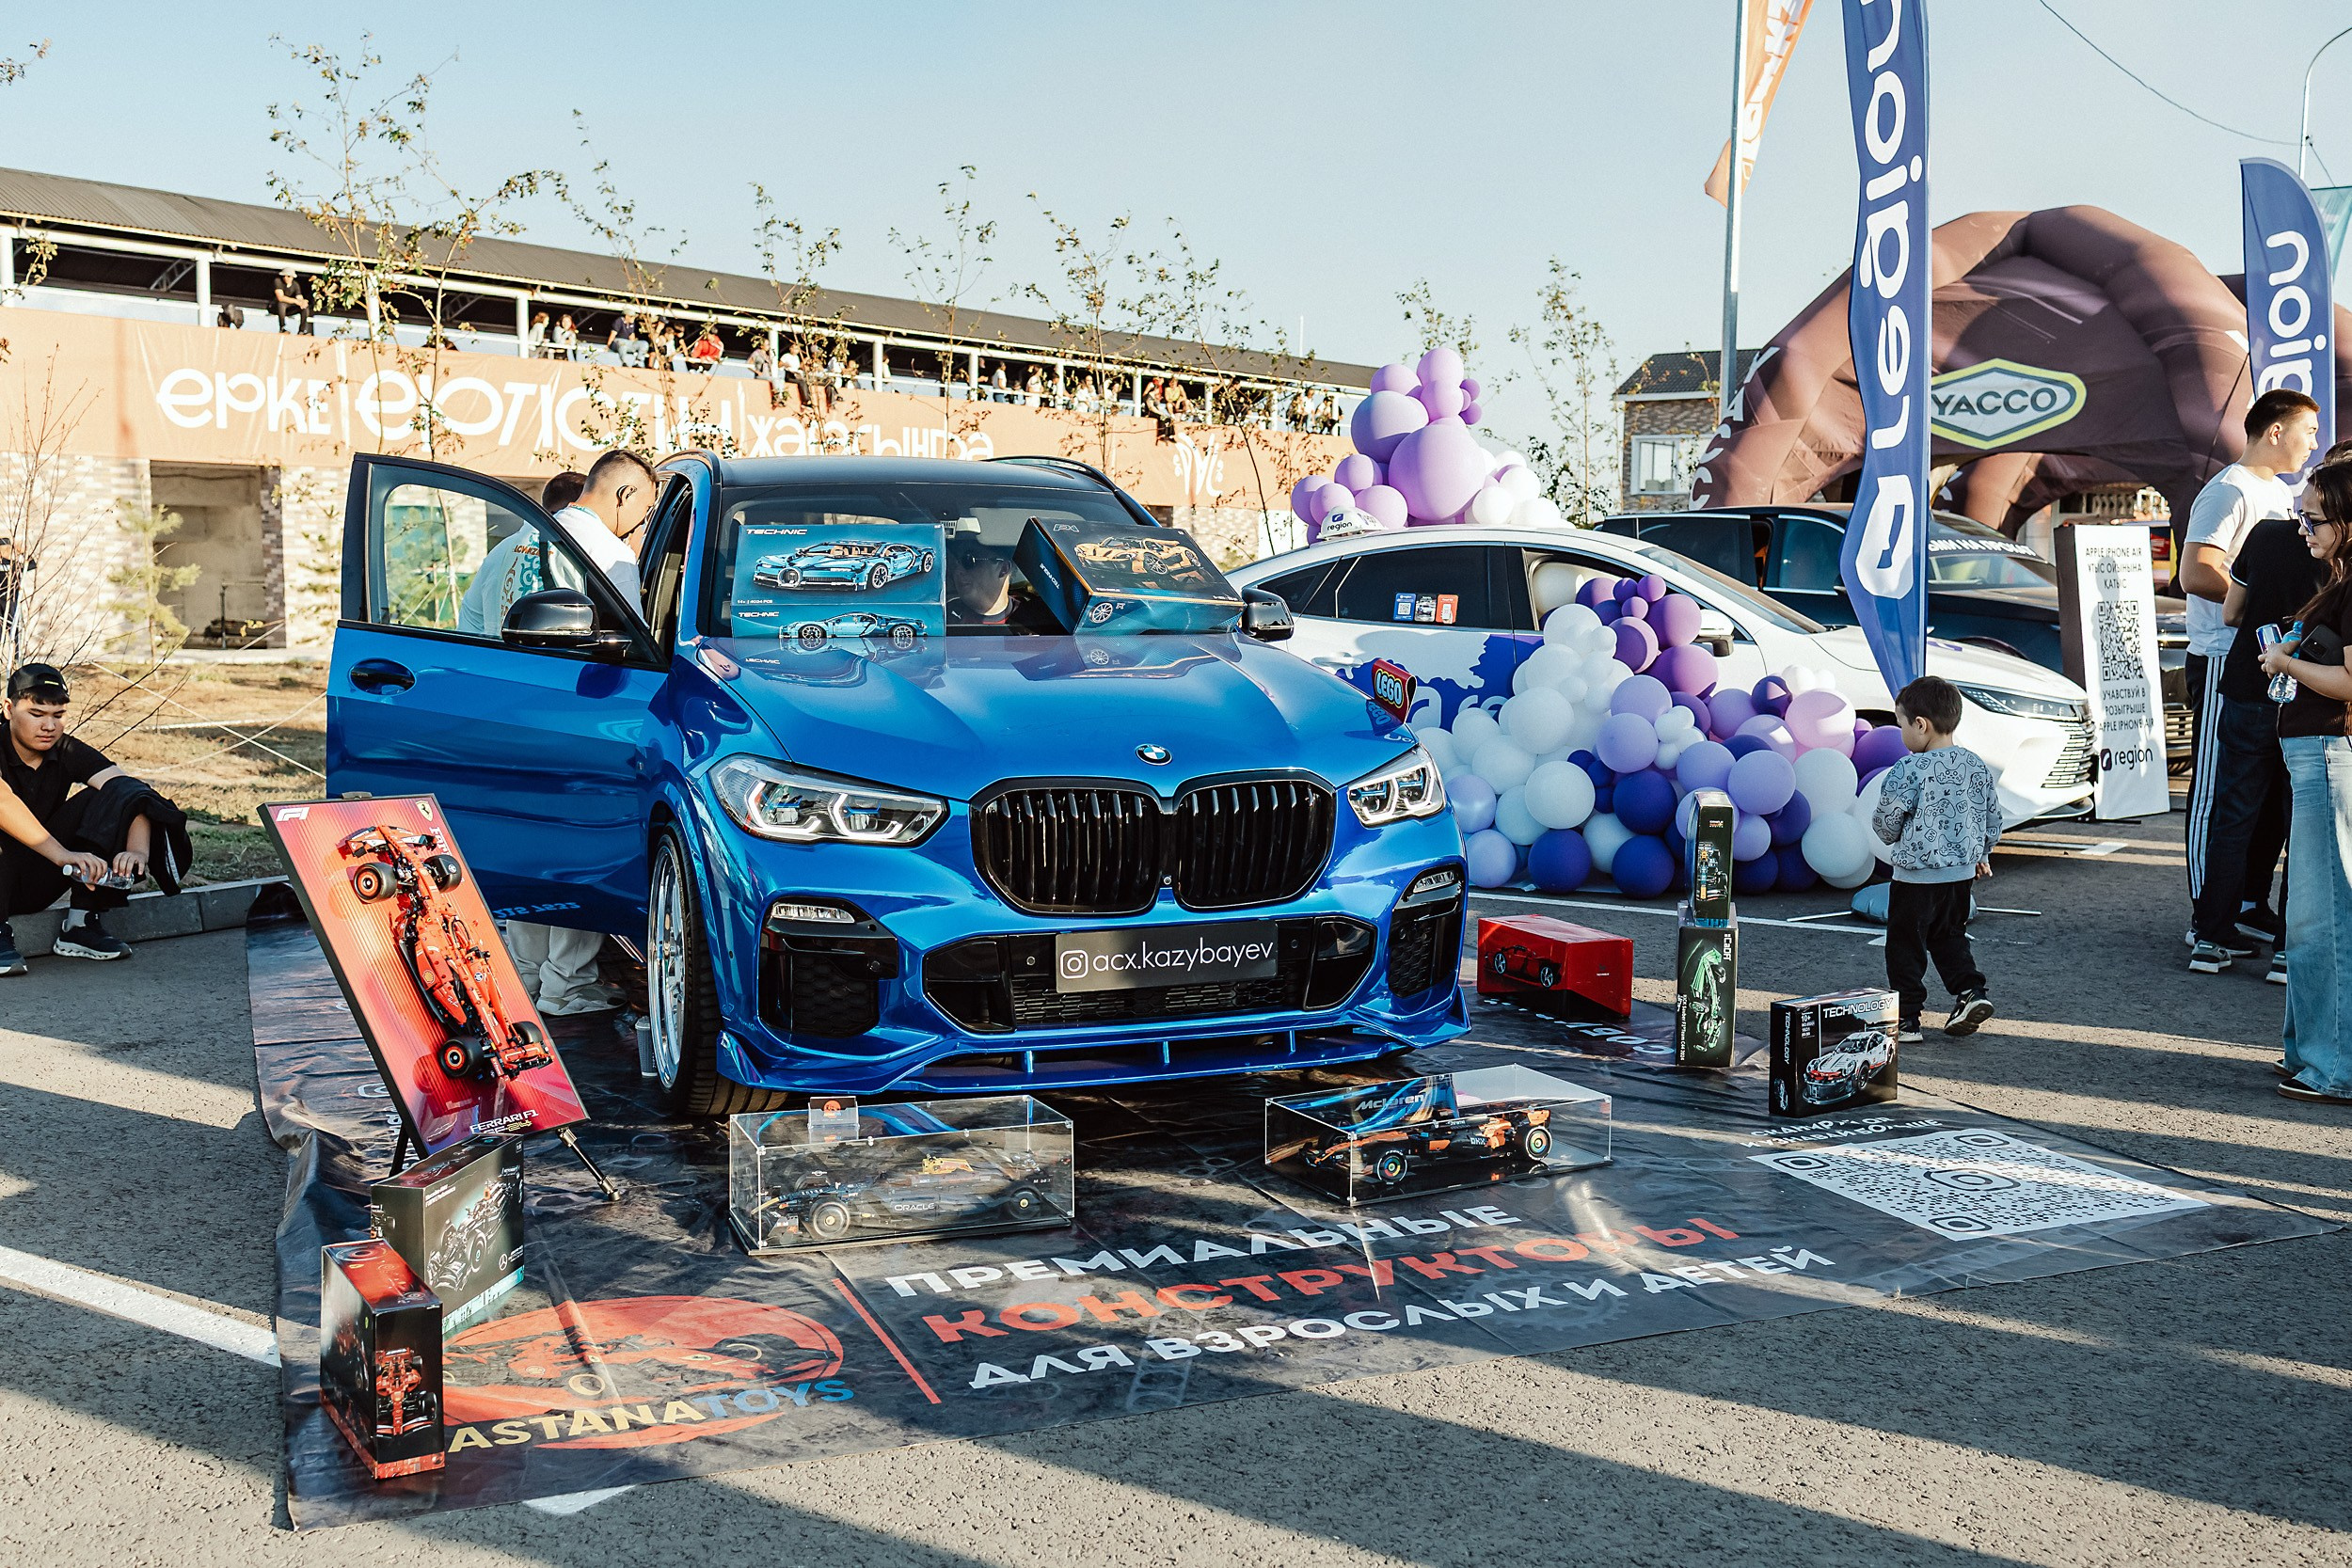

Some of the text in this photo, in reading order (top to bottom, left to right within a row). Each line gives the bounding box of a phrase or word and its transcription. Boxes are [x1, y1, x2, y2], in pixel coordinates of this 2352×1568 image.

[1931, 388, 2058, 417] YACCO
[1689, 346, 1781, 510] YACC
[1327, 521, 1353, 531] region
[2086, 547, 2142, 558] APPLE IPHONE AIR
[1375, 669, 1403, 707] LEGO
[2103, 685, 2146, 701] УЧАВСТВУЙ В
[2106, 703, 2146, 716] РОЗЫГРЫШЕ
[2099, 718, 2154, 732] APPLE IPHONE AIR
[2114, 744, 2153, 770] region
[1092, 936, 1275, 972] acx.kazybayev
[1801, 1014, 1811, 1023] 10+
[1823, 997, 1894, 1019] TECHNOLOGY
[1355, 1094, 1426, 1112] McLaren
[469, 1109, 539, 1133] FERRARI F1
[894, 1202, 936, 1212] ORACLE
[884, 1204, 1522, 1298] ПРЕМИАЛЬНЫЕ
[920, 1216, 1740, 1343] КОНСТРУКТОРЫ
[967, 1244, 1838, 1390] ДЛЯ ВЗРОСЛЫХ И ДЕТЕЙ
